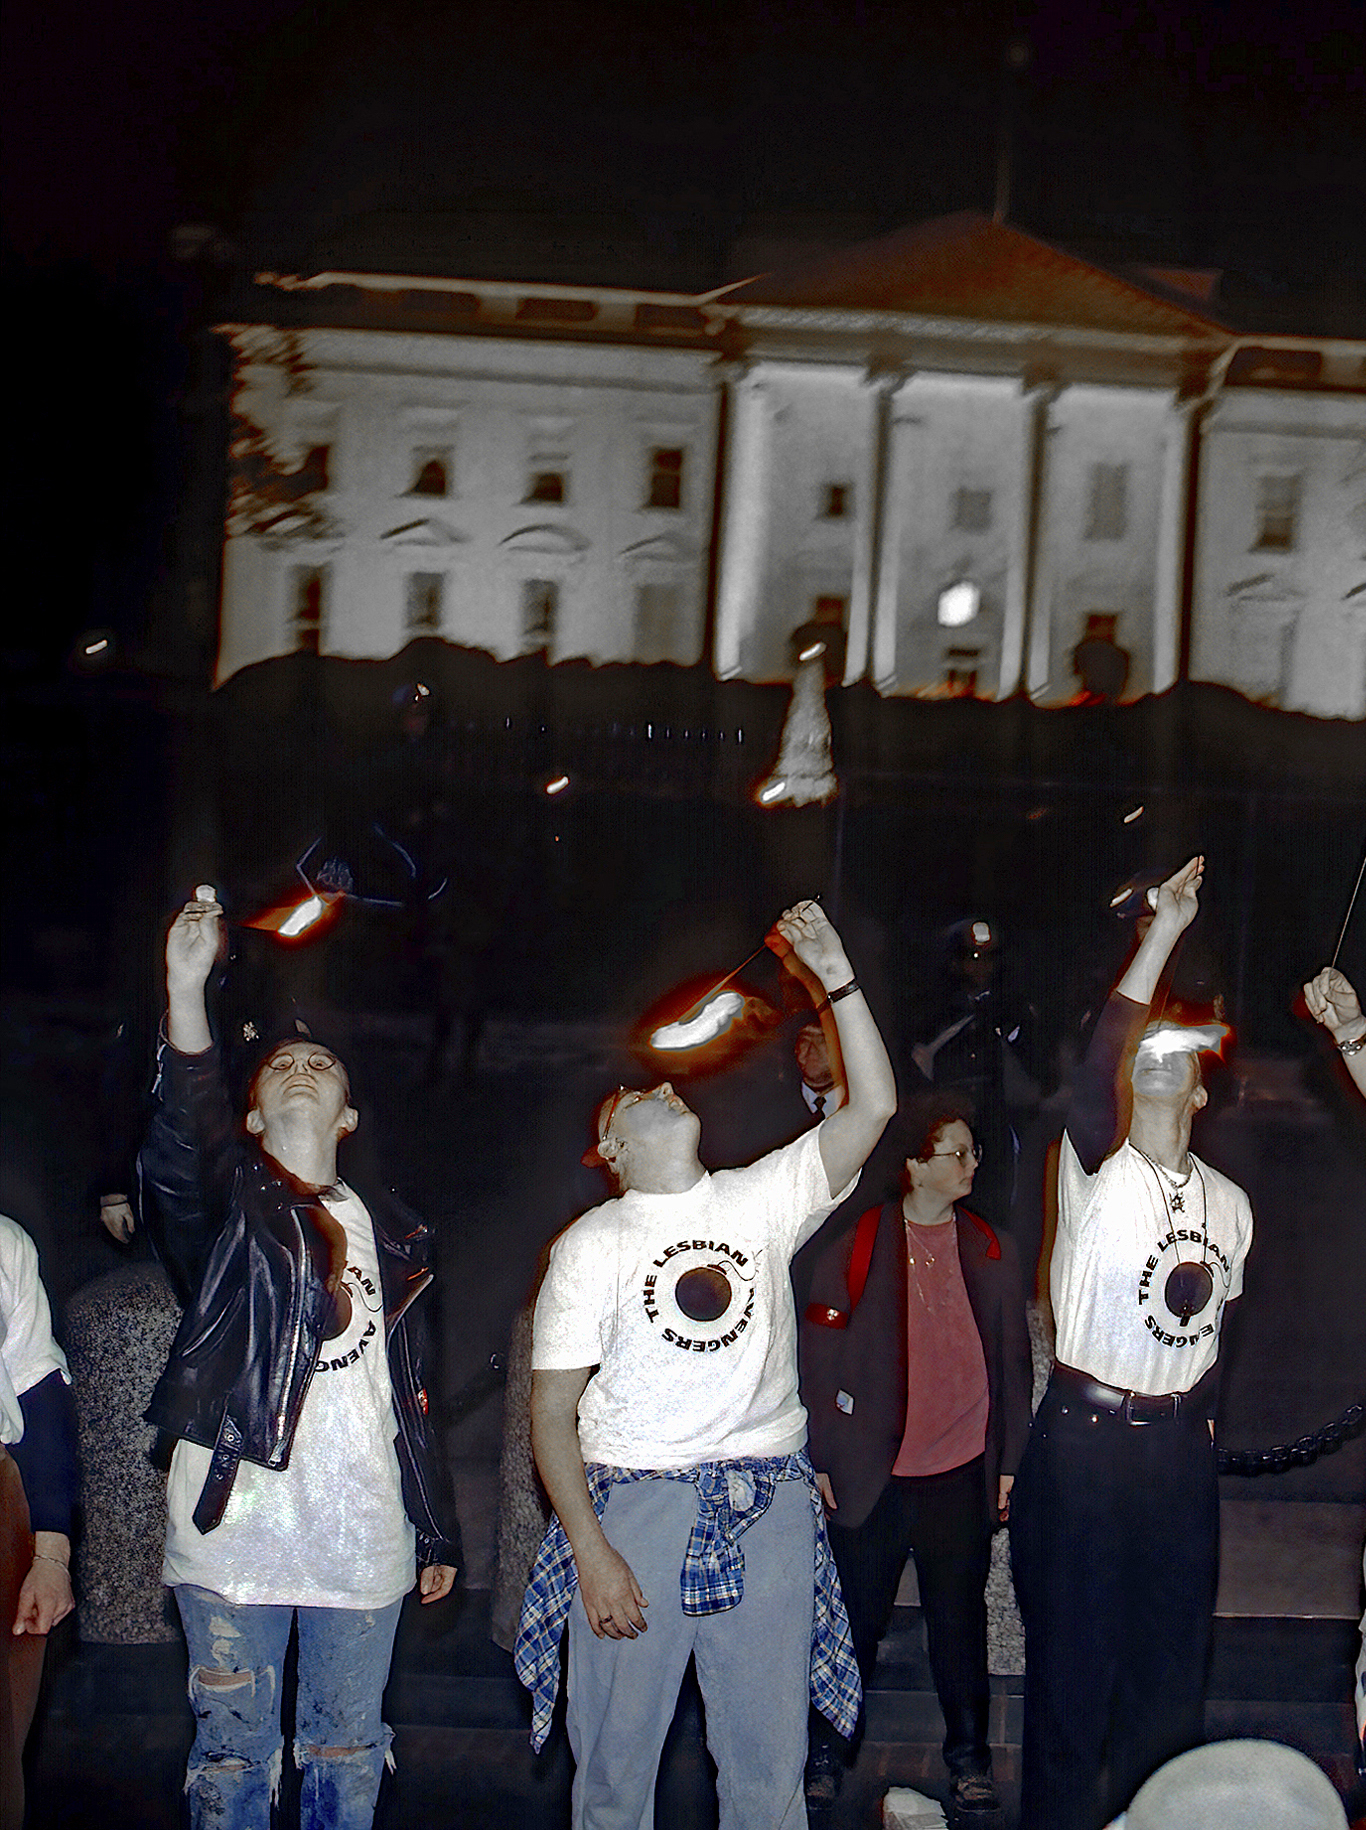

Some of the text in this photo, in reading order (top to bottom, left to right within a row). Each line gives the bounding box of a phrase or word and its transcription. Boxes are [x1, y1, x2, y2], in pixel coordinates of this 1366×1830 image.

[643, 1274, 659, 1323] THE
[653, 1239, 749, 1268] LESBIAN
[1138, 1254, 1159, 1305] THE
[1157, 1229, 1230, 1272] LESBIAN
